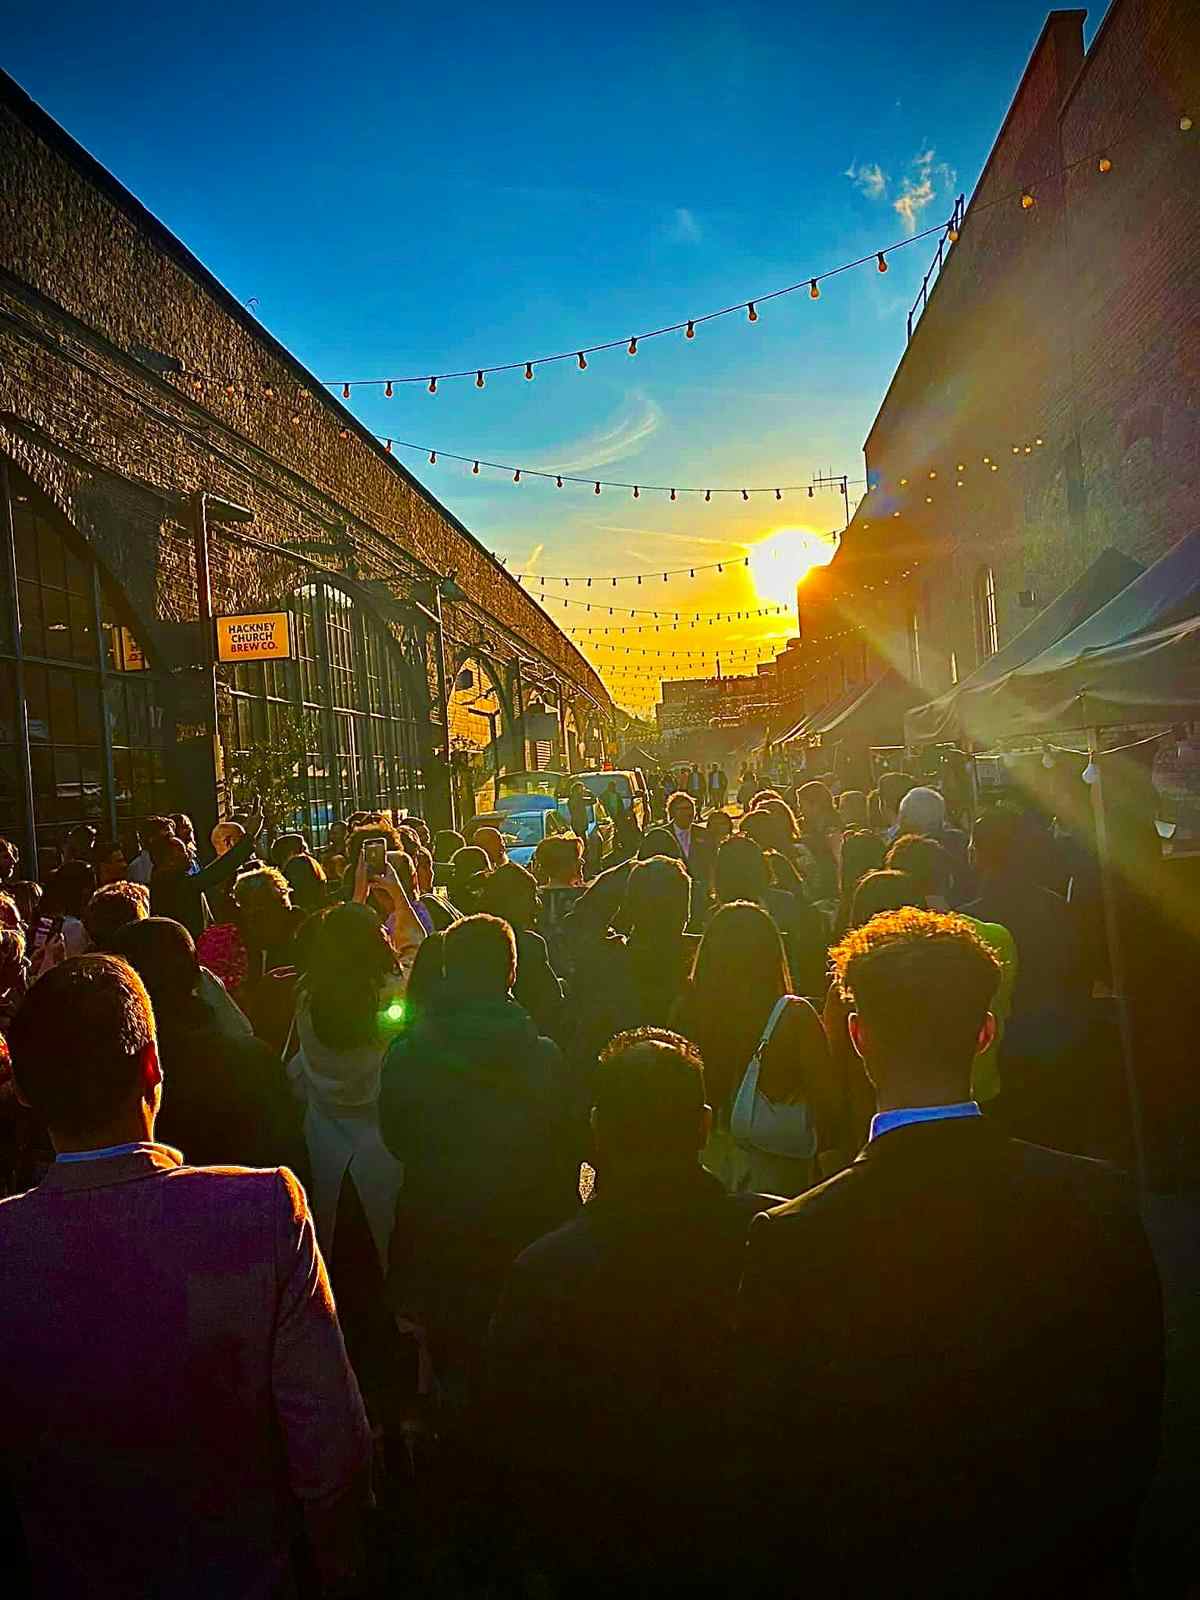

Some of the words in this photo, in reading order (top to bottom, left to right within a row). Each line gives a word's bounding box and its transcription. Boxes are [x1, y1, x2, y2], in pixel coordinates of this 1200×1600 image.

[228, 622, 276, 634] HACKNEY
[231, 632, 273, 643] CHURCH
[231, 642, 259, 653] BREW
[261, 641, 279, 650] CO.
